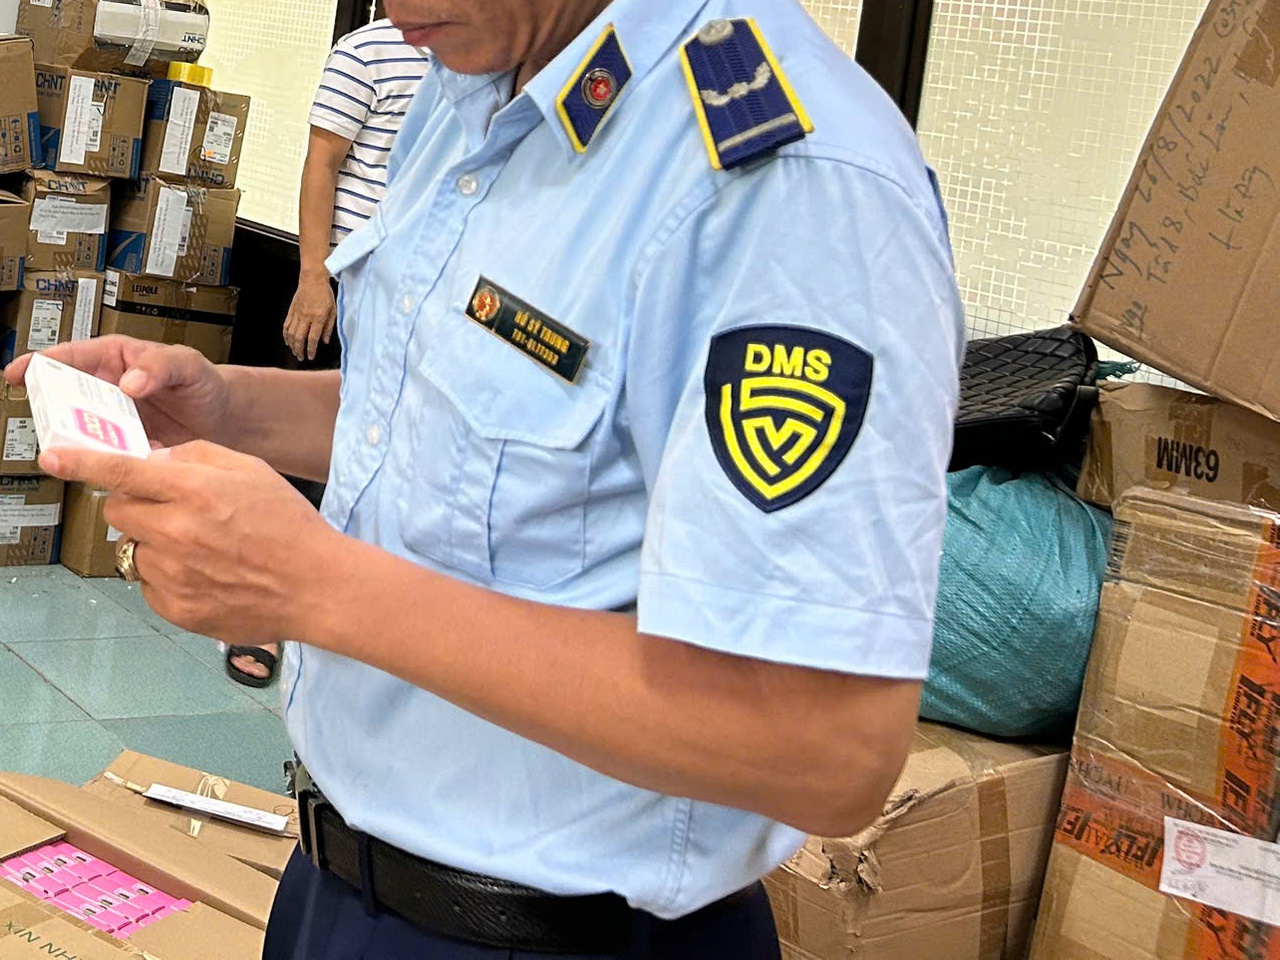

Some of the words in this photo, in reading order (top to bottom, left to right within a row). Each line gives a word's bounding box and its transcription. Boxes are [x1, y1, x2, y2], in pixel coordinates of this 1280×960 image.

[36, 73, 65, 90] CHNT
[36, 278, 78, 290] CHNT
[745, 343, 832, 382] DMS
[1157, 436, 1220, 483] 63MM
[3, 920, 44, 944] XIN
